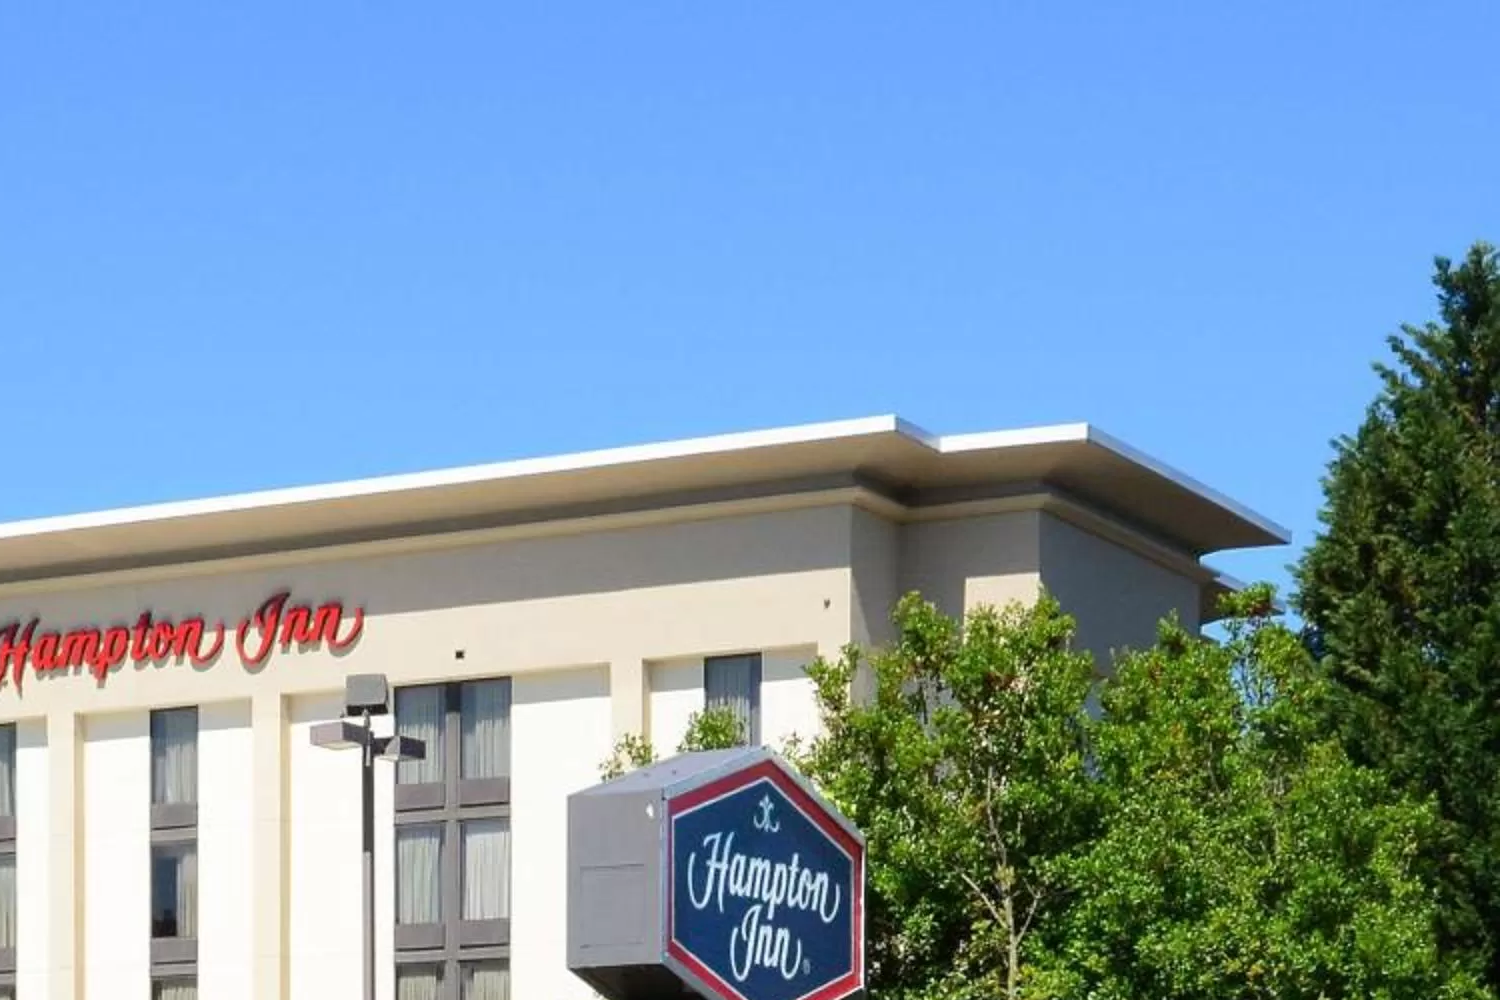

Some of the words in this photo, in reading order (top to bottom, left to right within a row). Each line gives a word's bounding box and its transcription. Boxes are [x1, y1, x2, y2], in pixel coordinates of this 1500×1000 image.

[235, 588, 365, 668] Inn
[687, 831, 841, 924] Hampton
[729, 904, 802, 982] Inn
